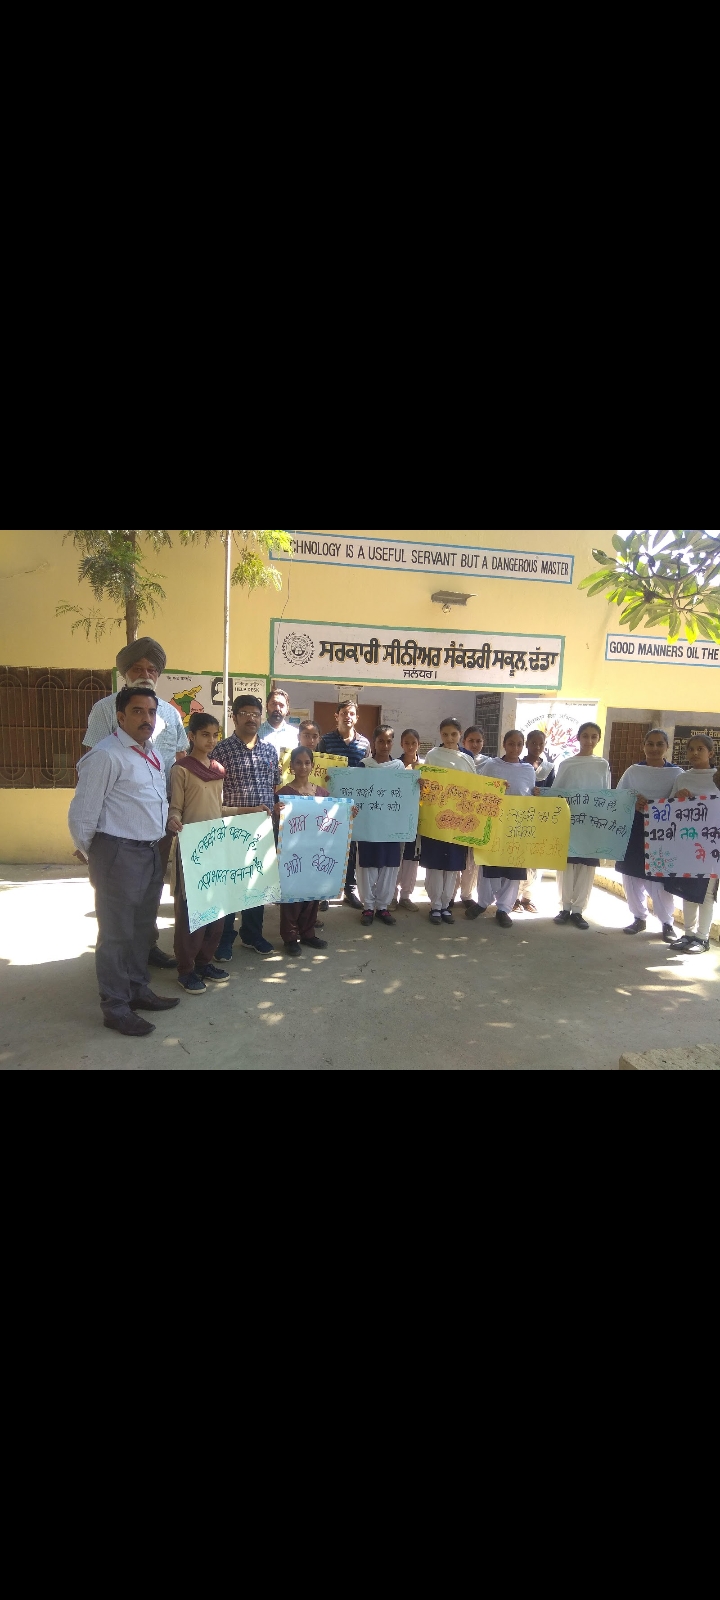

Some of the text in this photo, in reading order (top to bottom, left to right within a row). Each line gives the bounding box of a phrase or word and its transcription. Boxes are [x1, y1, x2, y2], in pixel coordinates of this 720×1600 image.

[283, 540, 569, 576] CHNOLOGY IS A USEFUL SERVANT BUT A DANGEROUS MASTER
[319, 638, 380, 664] ਸਰਕਾਰੀ
[609, 641, 719, 660] GOOD MANNERS OIL THE
[651, 803, 671, 822] बेटी
